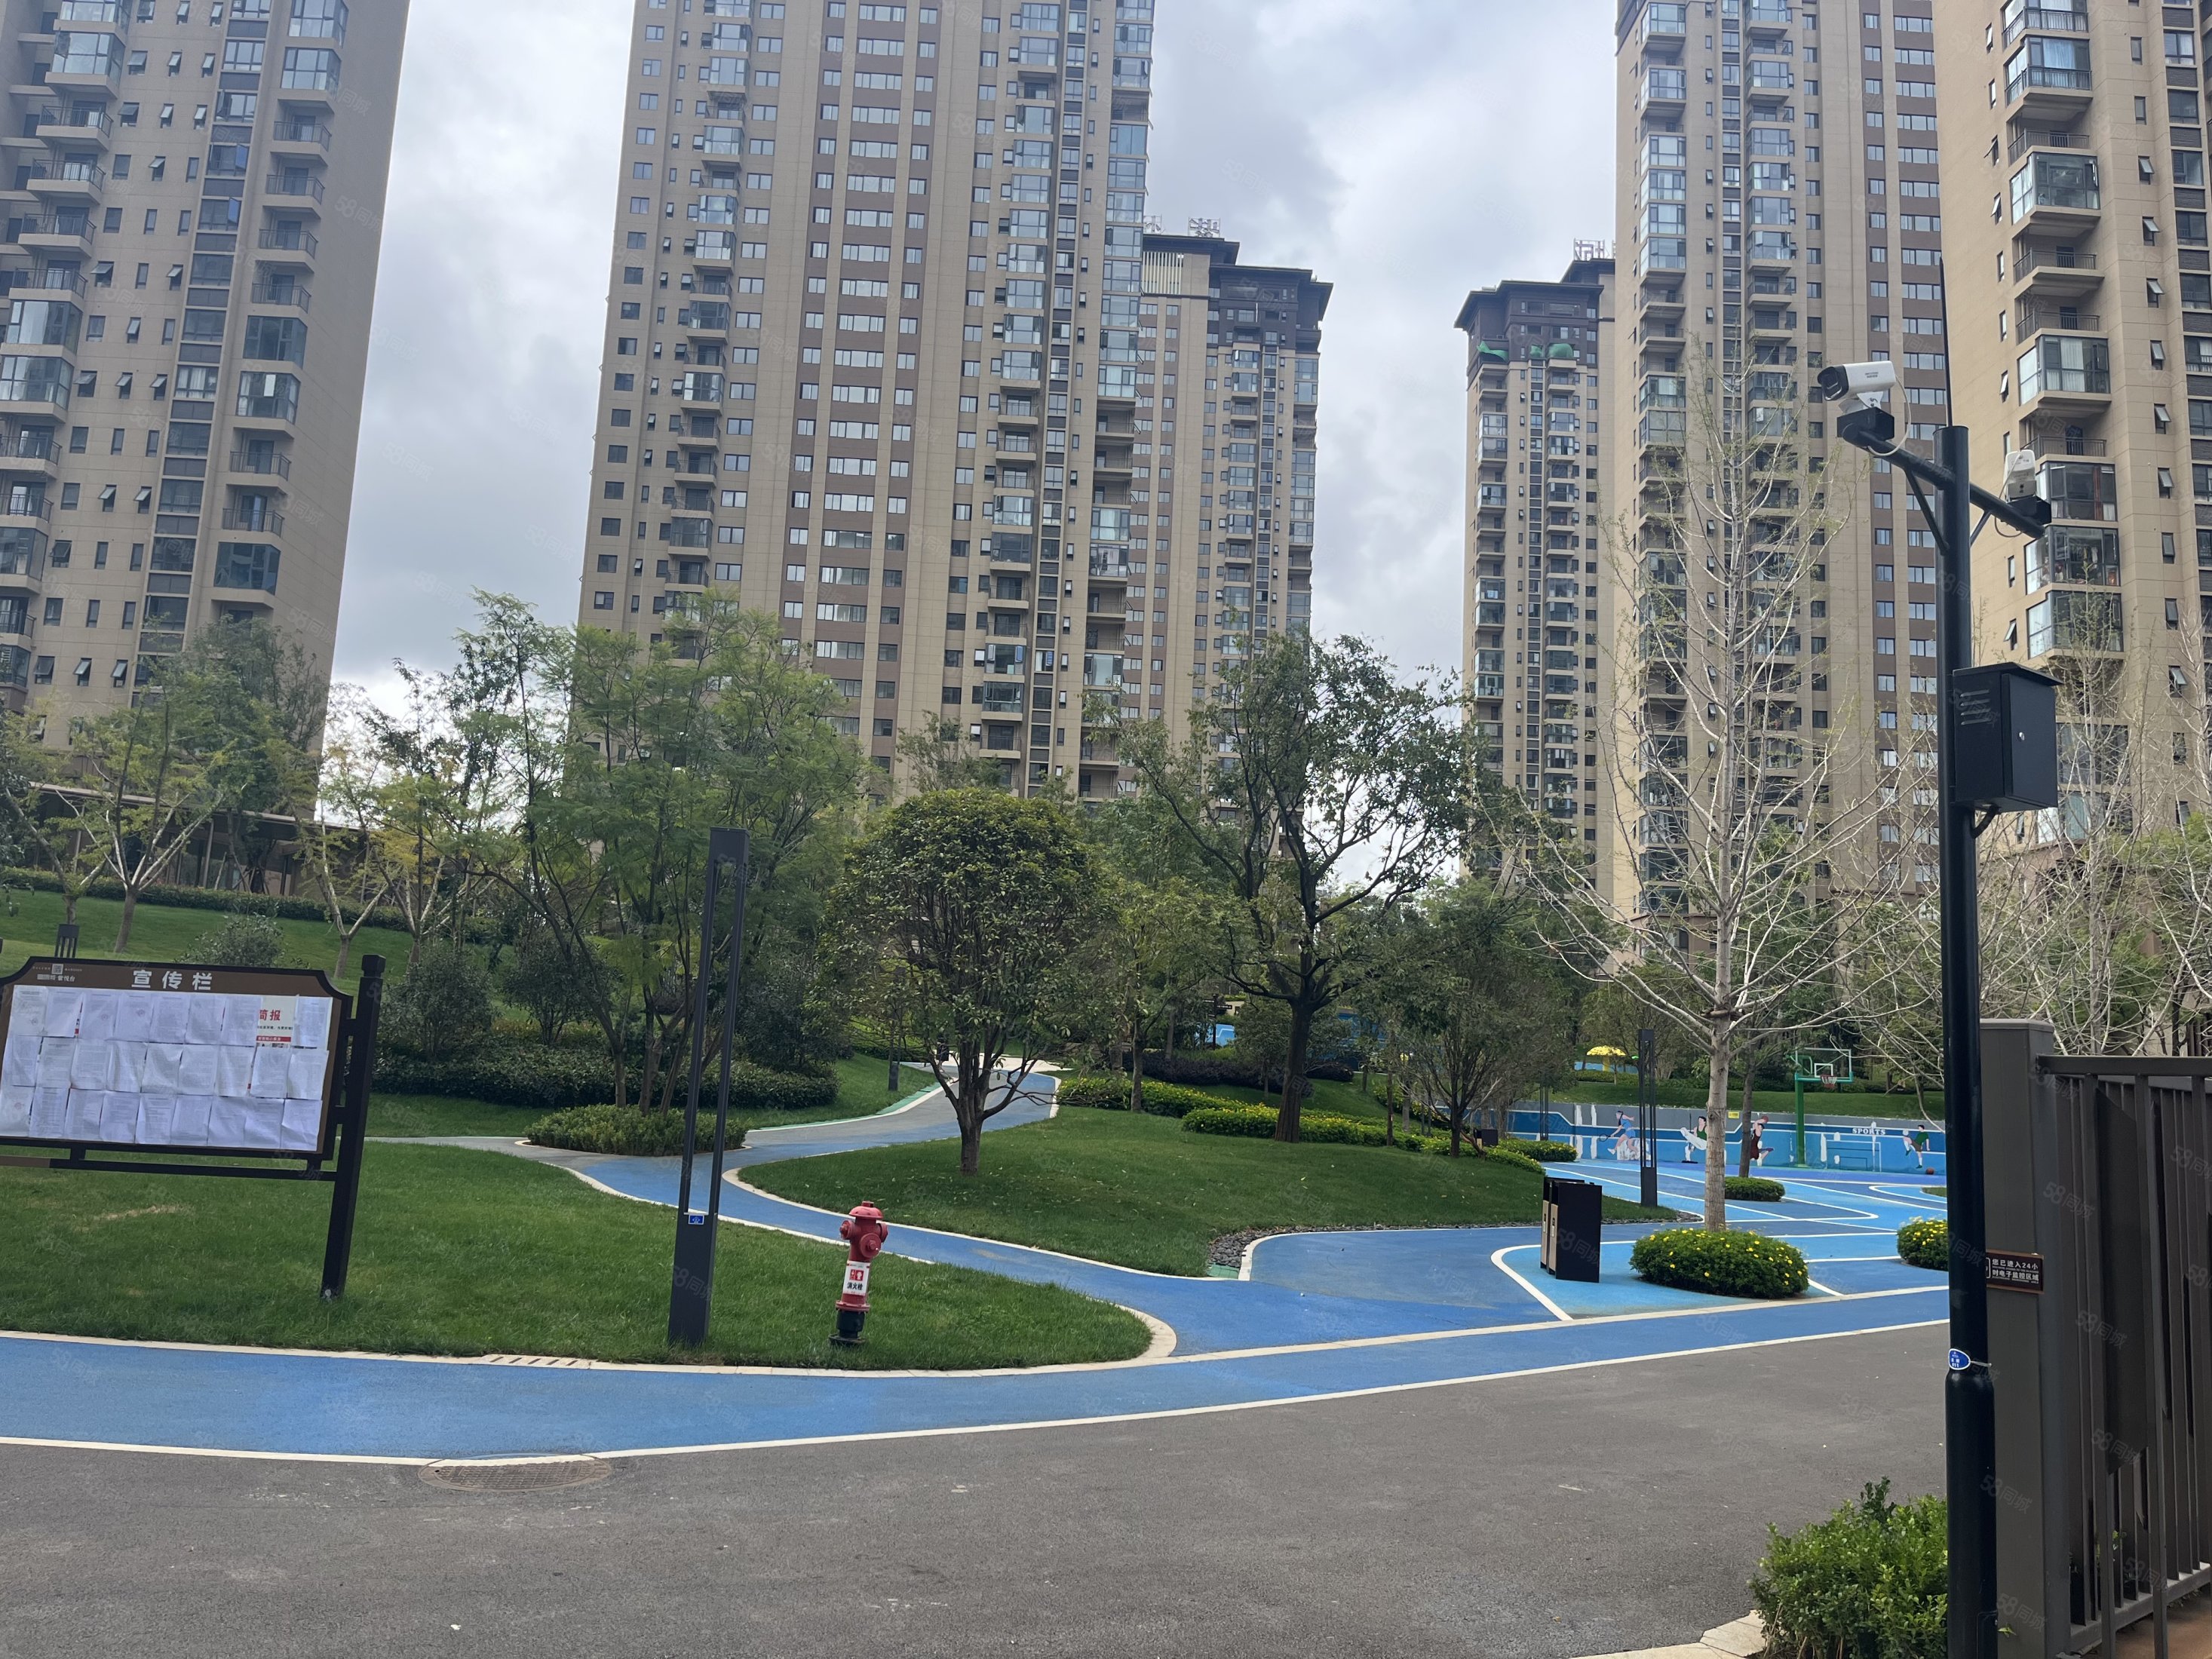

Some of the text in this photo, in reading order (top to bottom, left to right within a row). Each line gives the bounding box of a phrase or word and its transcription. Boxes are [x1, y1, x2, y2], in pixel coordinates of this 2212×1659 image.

[131, 970, 212, 990] 宣传栏
[1992, 1259, 2039, 1270] 您已进入24小
[847, 1282, 863, 1290] 消火栓
